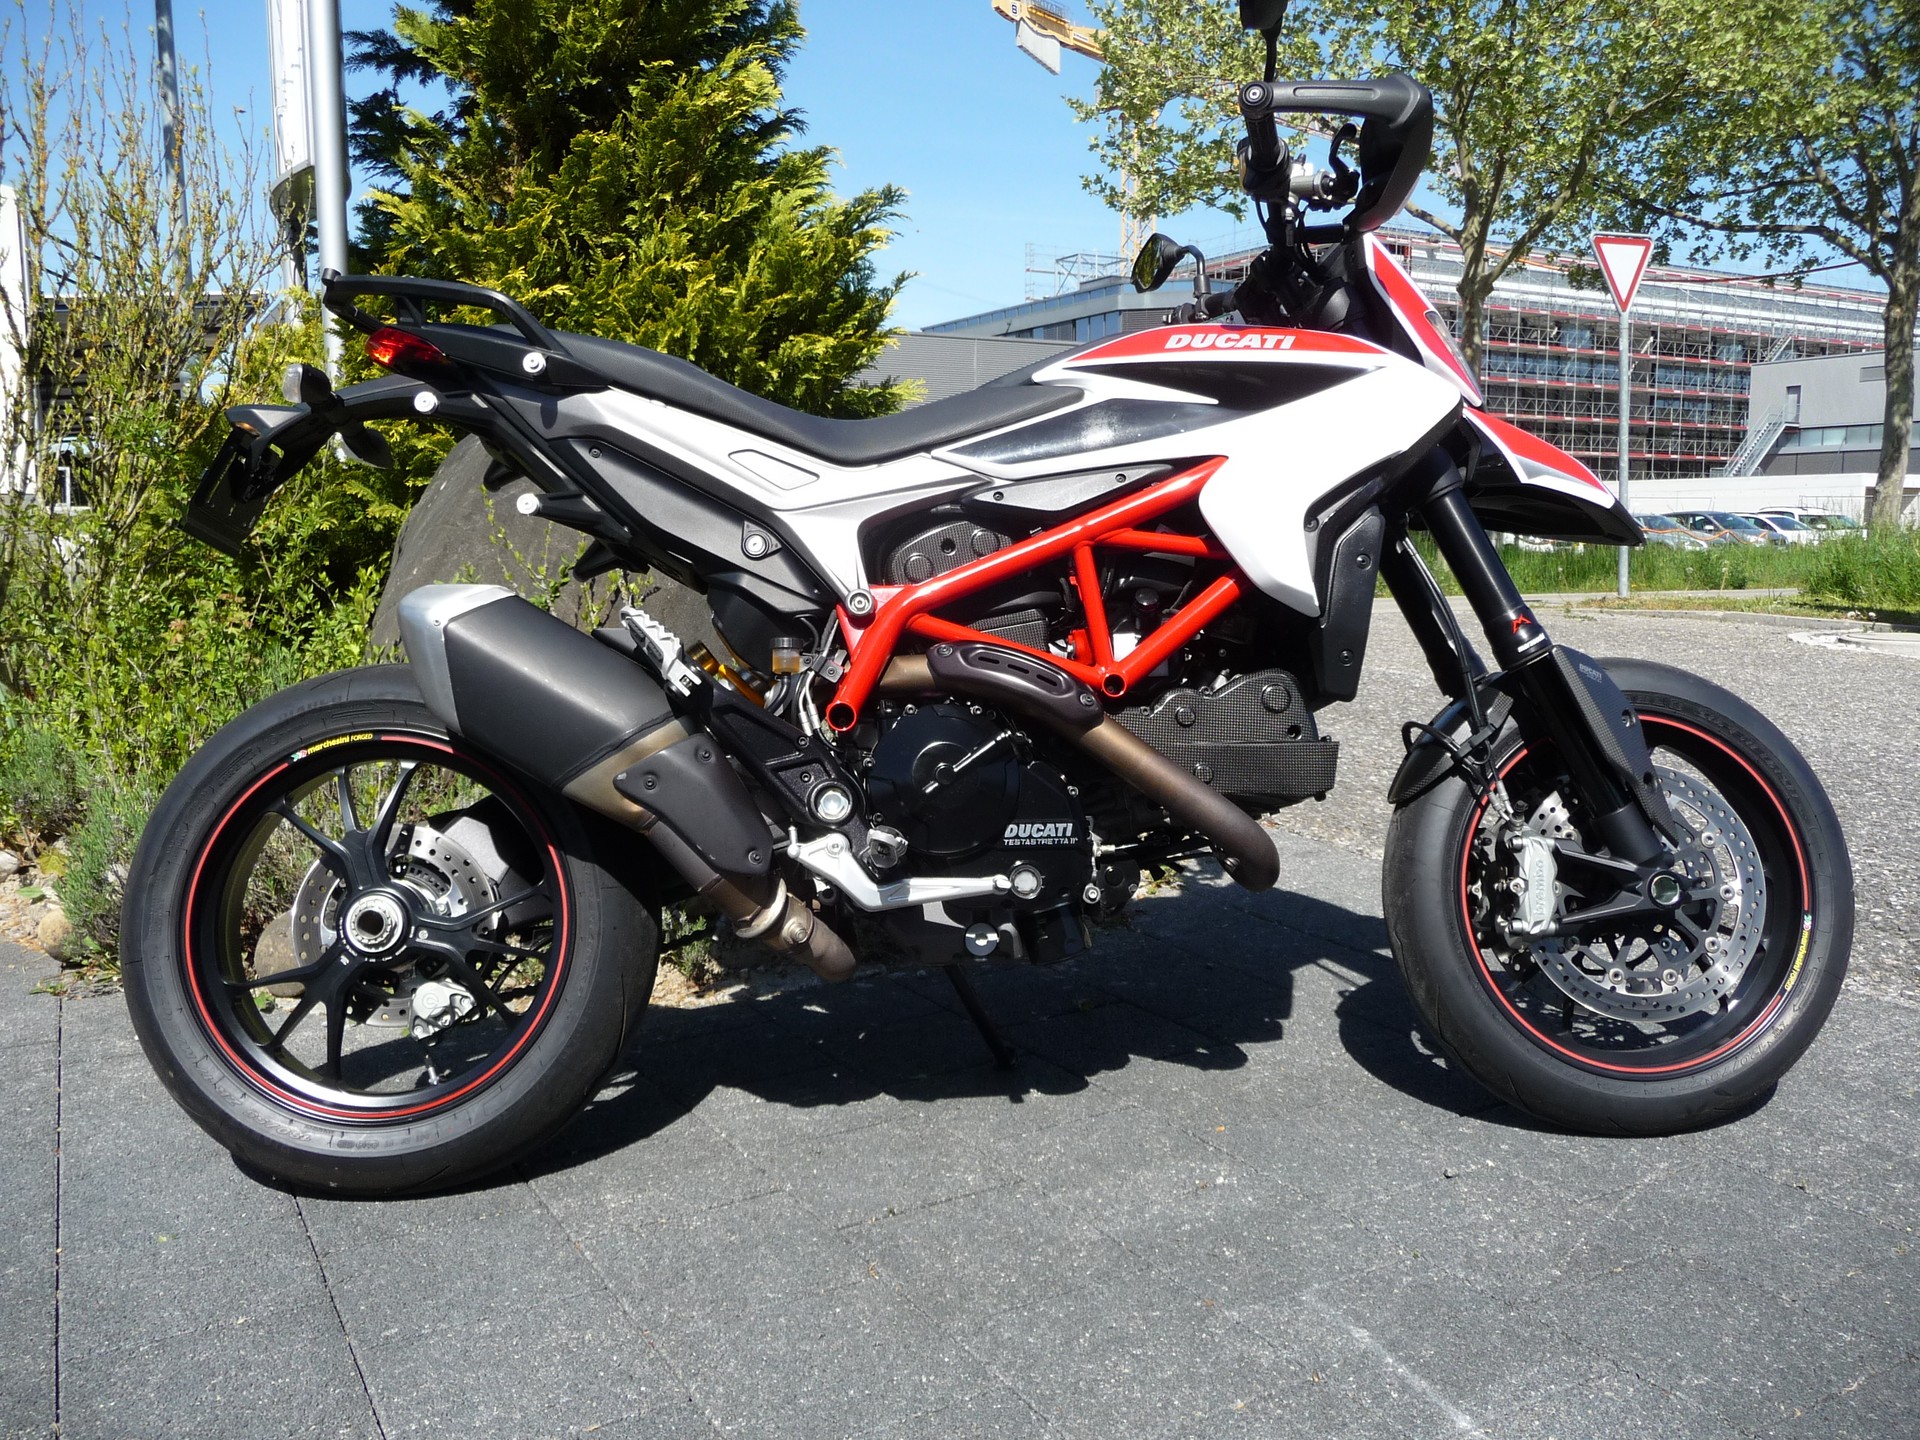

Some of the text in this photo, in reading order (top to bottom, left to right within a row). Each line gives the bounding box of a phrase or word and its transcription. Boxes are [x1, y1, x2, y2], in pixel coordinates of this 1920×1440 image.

[1164, 333, 1296, 349] DUCATI
[307, 733, 373, 755] marchesini FORGED
[1004, 823, 1073, 838] DUCATI
[1003, 838, 1069, 846] TESTASTRETTA
[1533, 859, 1545, 916] brembo
